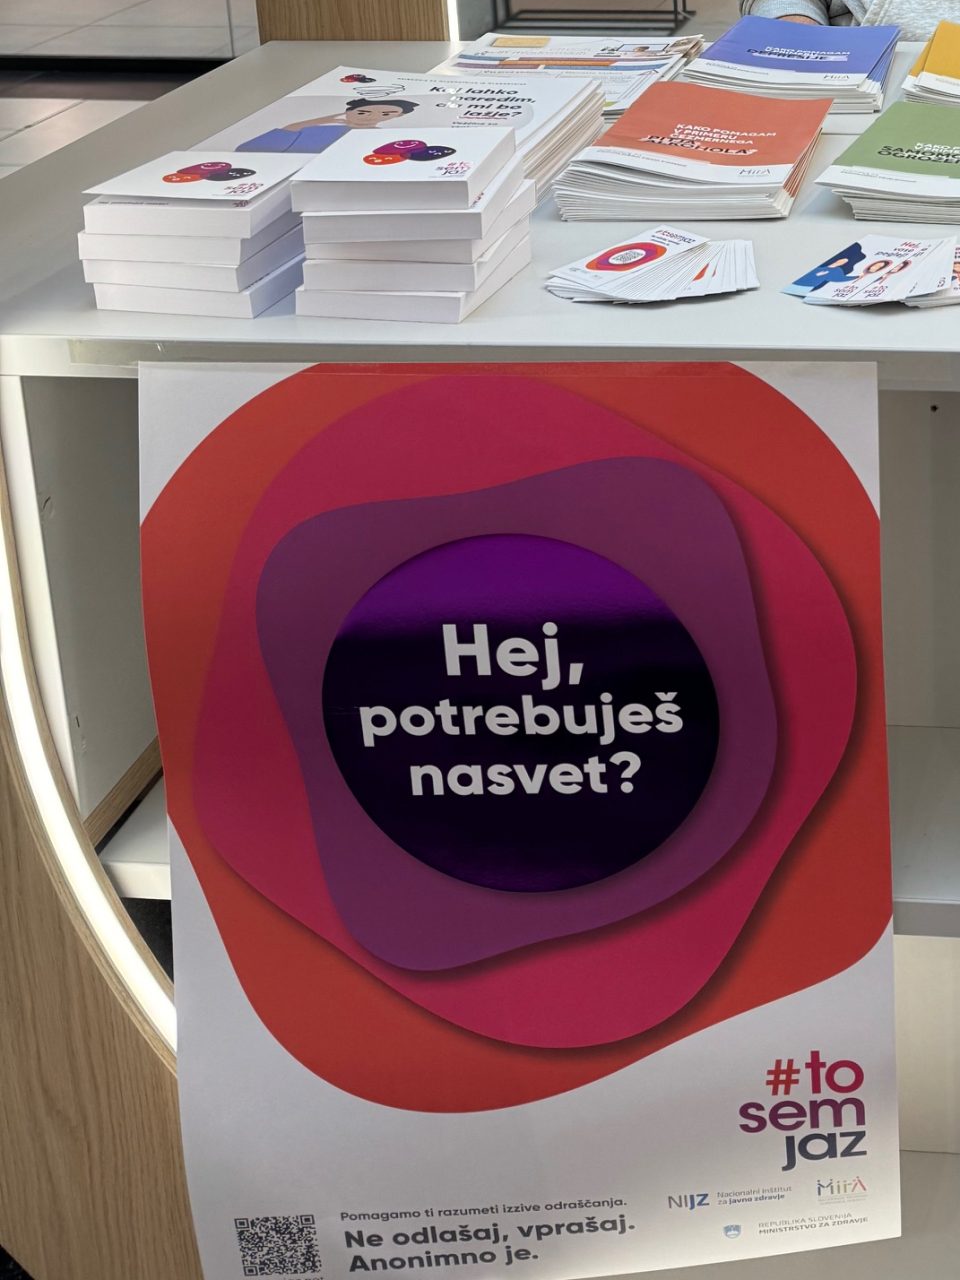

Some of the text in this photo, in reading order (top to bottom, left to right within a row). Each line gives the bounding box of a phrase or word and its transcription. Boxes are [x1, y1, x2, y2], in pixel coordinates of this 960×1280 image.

[442, 621, 584, 691] Hej,
[359, 691, 684, 747] potrebuješ
[410, 751, 642, 796] nasvet?
[765, 1050, 865, 1096] #to
[738, 1097, 867, 1133] sem
[781, 1130, 867, 1171] jaz
[668, 1193, 710, 1210] NIJZ
[716, 1185, 792, 1199] Nacionalni inštitut
[717, 1193, 785, 1206] za javno zdravje
[340, 1197, 627, 1221] Pomagamo ti razumeti izzive odraščanja.
[758, 1217, 807, 1228] REPUBLIKA
[344, 1214, 635, 1248] Ne odlašaj, vprašaj.
[758, 1217, 869, 1235] MINISTRSTVO ZA ZDRAVJE
[349, 1245, 539, 1272] Anonimno je.
